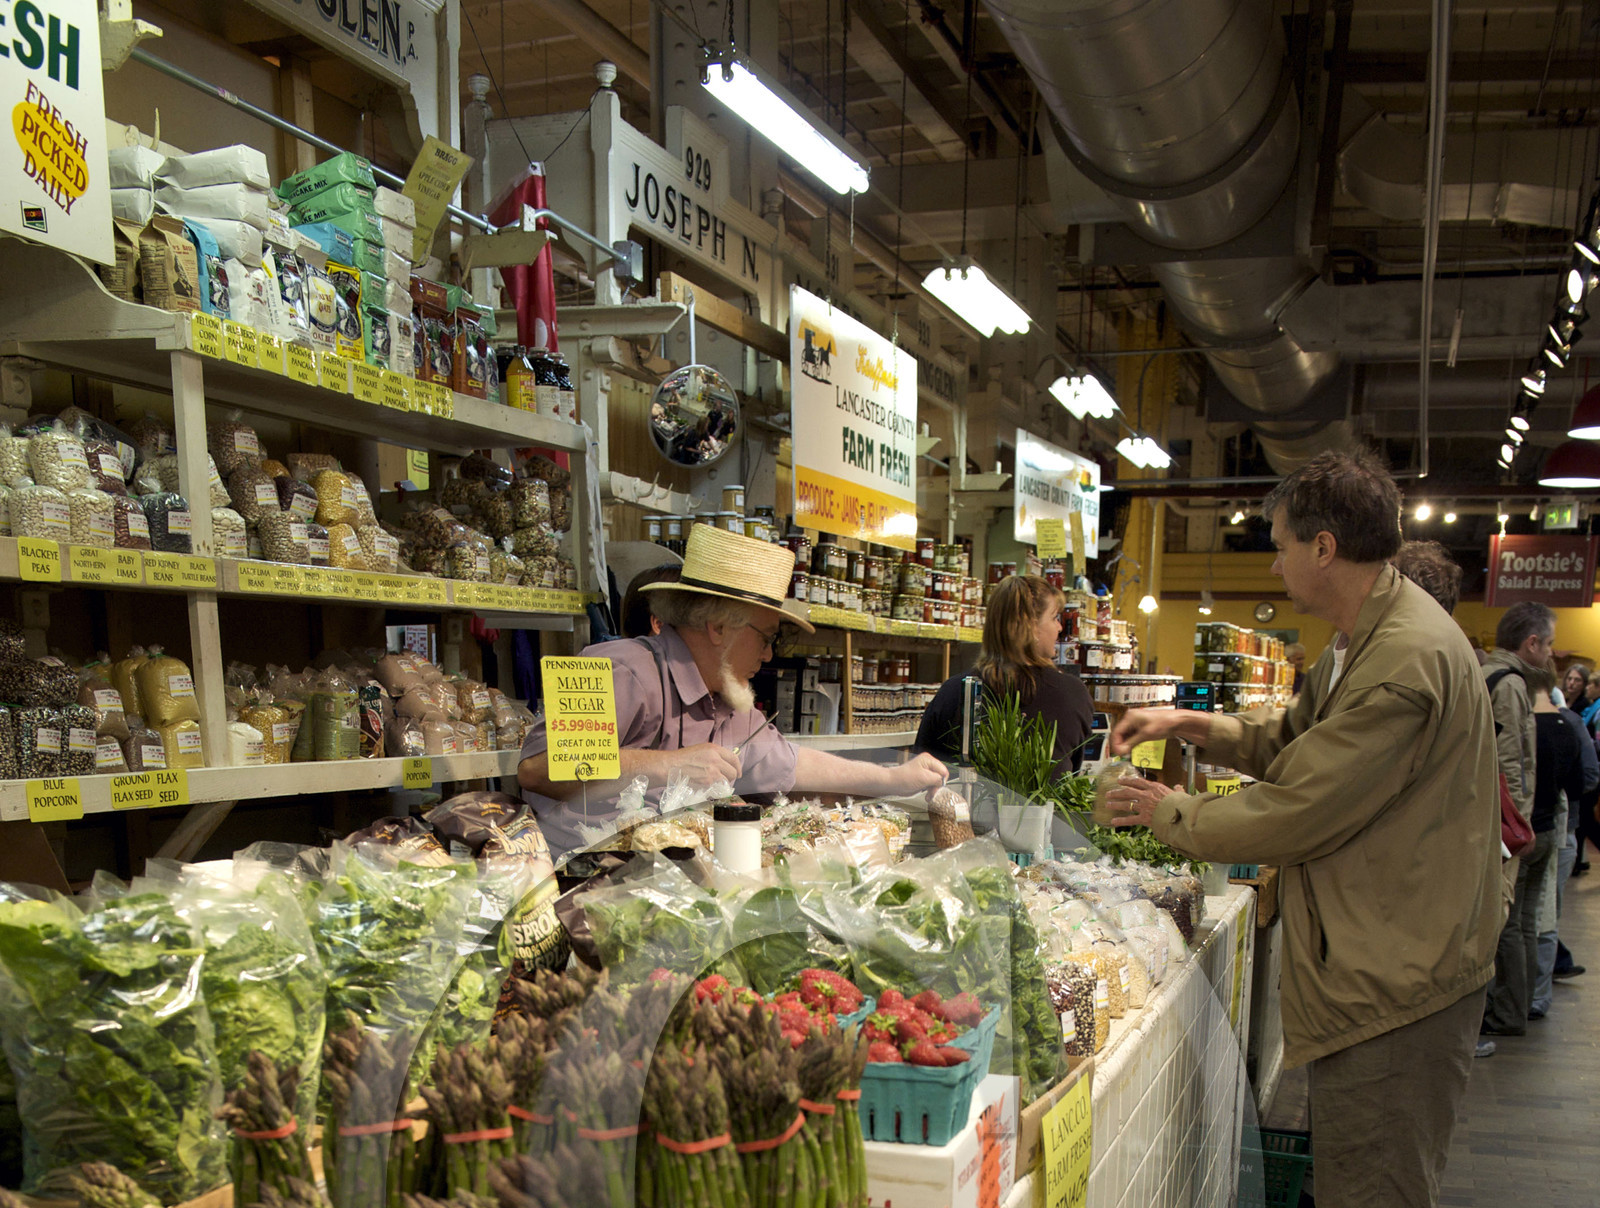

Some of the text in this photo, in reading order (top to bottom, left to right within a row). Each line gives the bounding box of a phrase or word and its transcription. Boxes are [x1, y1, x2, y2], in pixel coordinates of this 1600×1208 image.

[25, 79, 88, 162] FRESH
[21, 110, 86, 193] PICKED
[434, 147, 458, 166] BRAGG
[686, 146, 711, 191] 929
[23, 149, 77, 216] DAILY
[313, 179, 328, 191] MIX
[418, 184, 441, 200] VINEGAR
[313, 209, 327, 221] MIX
[625, 162, 727, 262] JOSEPH
[195, 315, 219, 330] YELLOW
[199, 330, 217, 342] CORN
[200, 343, 217, 356] MEAL
[266, 350, 278, 360] MIX
[298, 371, 309, 380] MIX
[323, 367, 347, 381] PANCAKE
[353, 362, 380, 378] BUTTERMILK
[330, 381, 340, 391] MIX
[356, 375, 378, 390] PANCAKE
[363, 389, 372, 399] MIX
[385, 396, 407, 410] PANCAKE
[836, 385, 915, 441] LANCASTER COUNTY
[842, 426, 911, 487] FARM FRESH
[1019, 474, 1051, 502] LANCASTER
[799, 480, 834, 519] PRODUCE
[841, 493, 859, 527] JAMS
[21, 546, 59, 561] BLACKEYE
[80, 549, 99, 557] GREAT
[73, 559, 106, 569] NORTHERN
[117, 555, 136, 565] BABY
[145, 558, 180, 570] RED KIDNEY
[189, 562, 207, 571] BLACK
[1501, 551, 1584, 573] Tootsie's
[32, 562, 51, 574] PEAS
[116, 568, 138, 579] LIMAS
[82, 572, 101, 581] BEANS
[153, 572, 173, 582] BEANS
[181, 572, 217, 583] TURTLE BEANS
[247, 579, 265, 588] BEANS
[1498, 575, 1583, 592] Salad Express
[545, 660, 610, 671] PENNSYLVANIA
[557, 676, 604, 691] MAPLE
[558, 697, 606, 712] SUGAR
[551, 719, 615, 735] $5.99@bag
[557, 739, 612, 748] GREAT ON ICE
[413, 759, 423, 768] RED
[552, 753, 618, 762] CREAM AND MUCH
[406, 771, 431, 781] POPCORN
[576, 766, 600, 776] MORE!
[43, 779, 66, 791] BLUE
[113, 773, 150, 788] GROUND
[156, 772, 179, 785] FLAX
[33, 795, 78, 809] POPCORN
[113, 789, 154, 804] FLAX SEED
[159, 790, 180, 803] SEED
[1046, 1124, 1092, 1196] FARM FRESH
